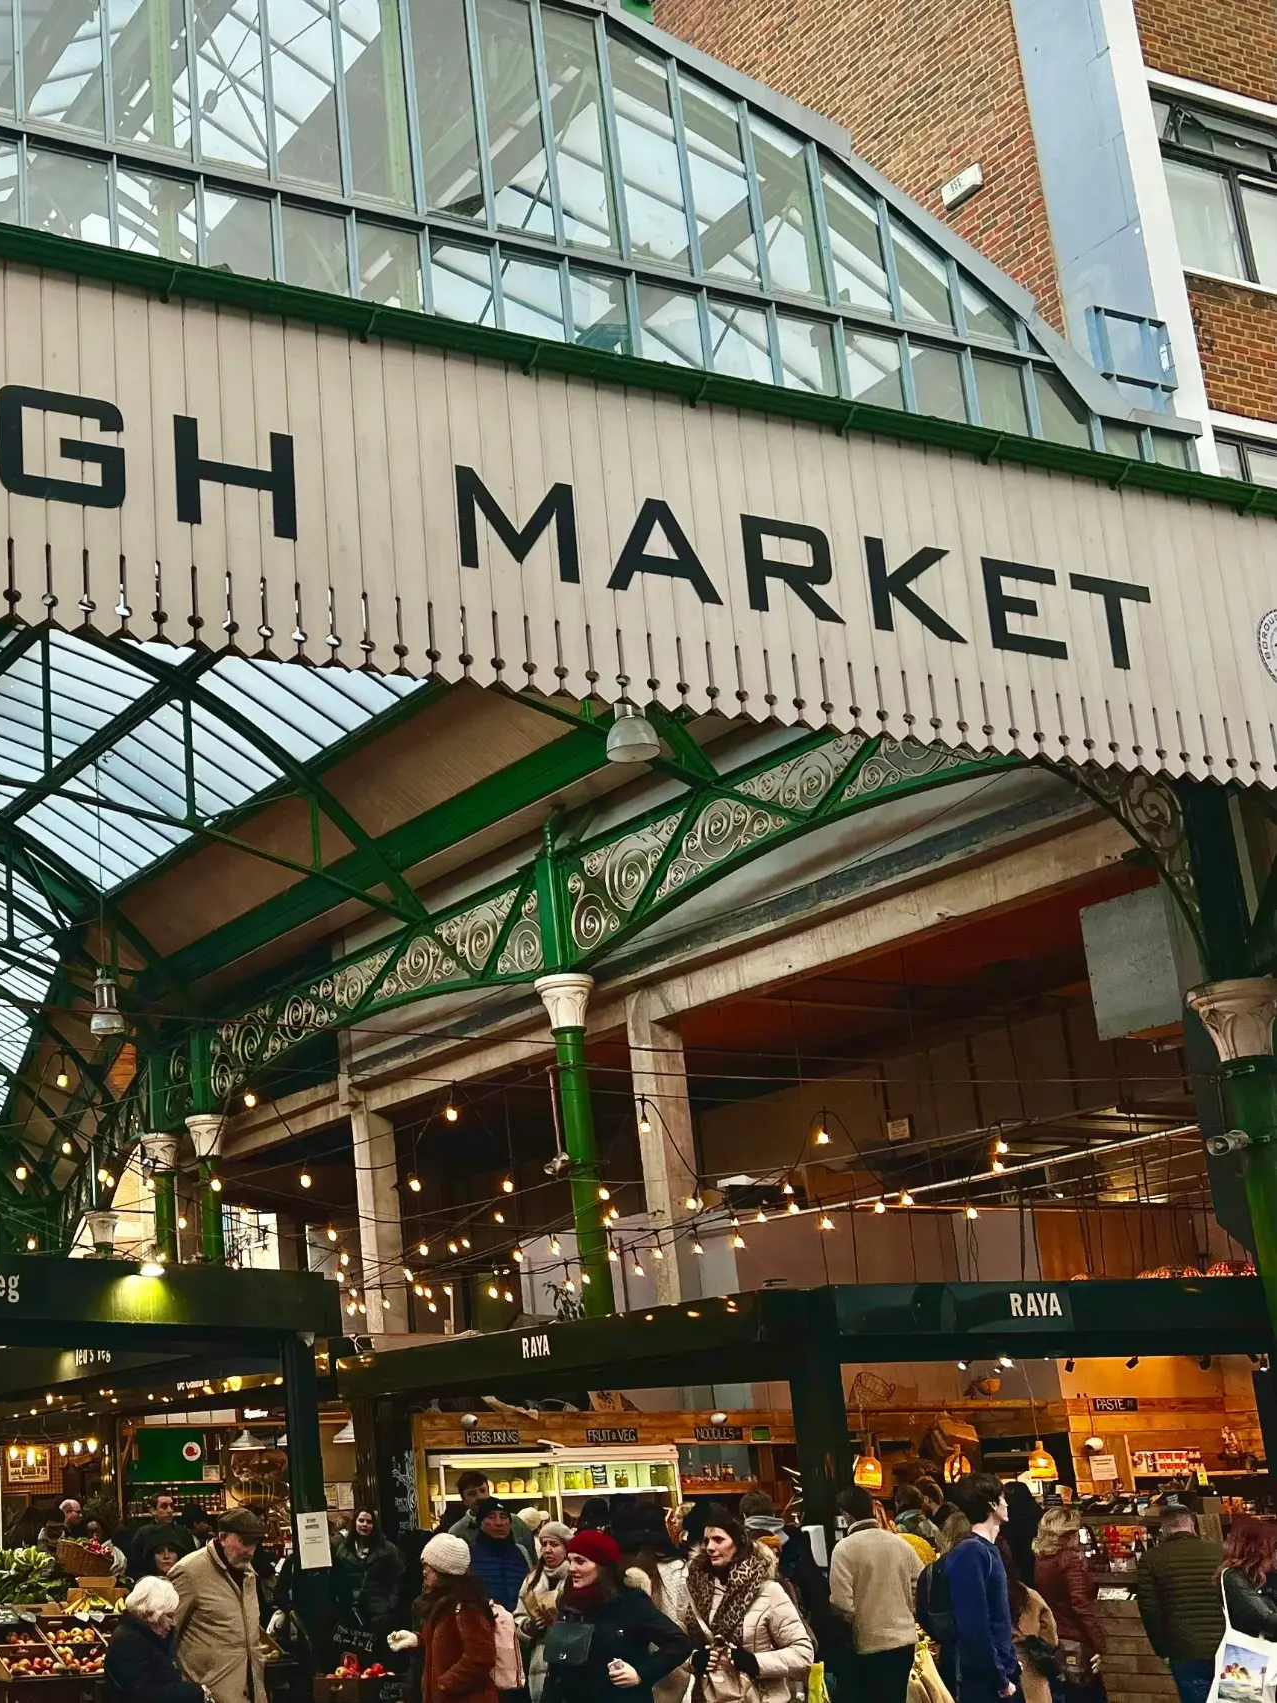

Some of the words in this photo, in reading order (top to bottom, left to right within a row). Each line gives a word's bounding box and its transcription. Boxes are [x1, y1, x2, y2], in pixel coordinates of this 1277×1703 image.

[455, 464, 1151, 671] MARKET
[1009, 1292, 1063, 1317] RAYA
[521, 1334, 551, 1359] RAYA
[1095, 1398, 1126, 1411] PASTE
[466, 1431, 492, 1444] HERBS
[587, 1430, 610, 1443] FRUIT
[617, 1429, 637, 1442] VEG
[696, 1427, 735, 1440] NOODLES
